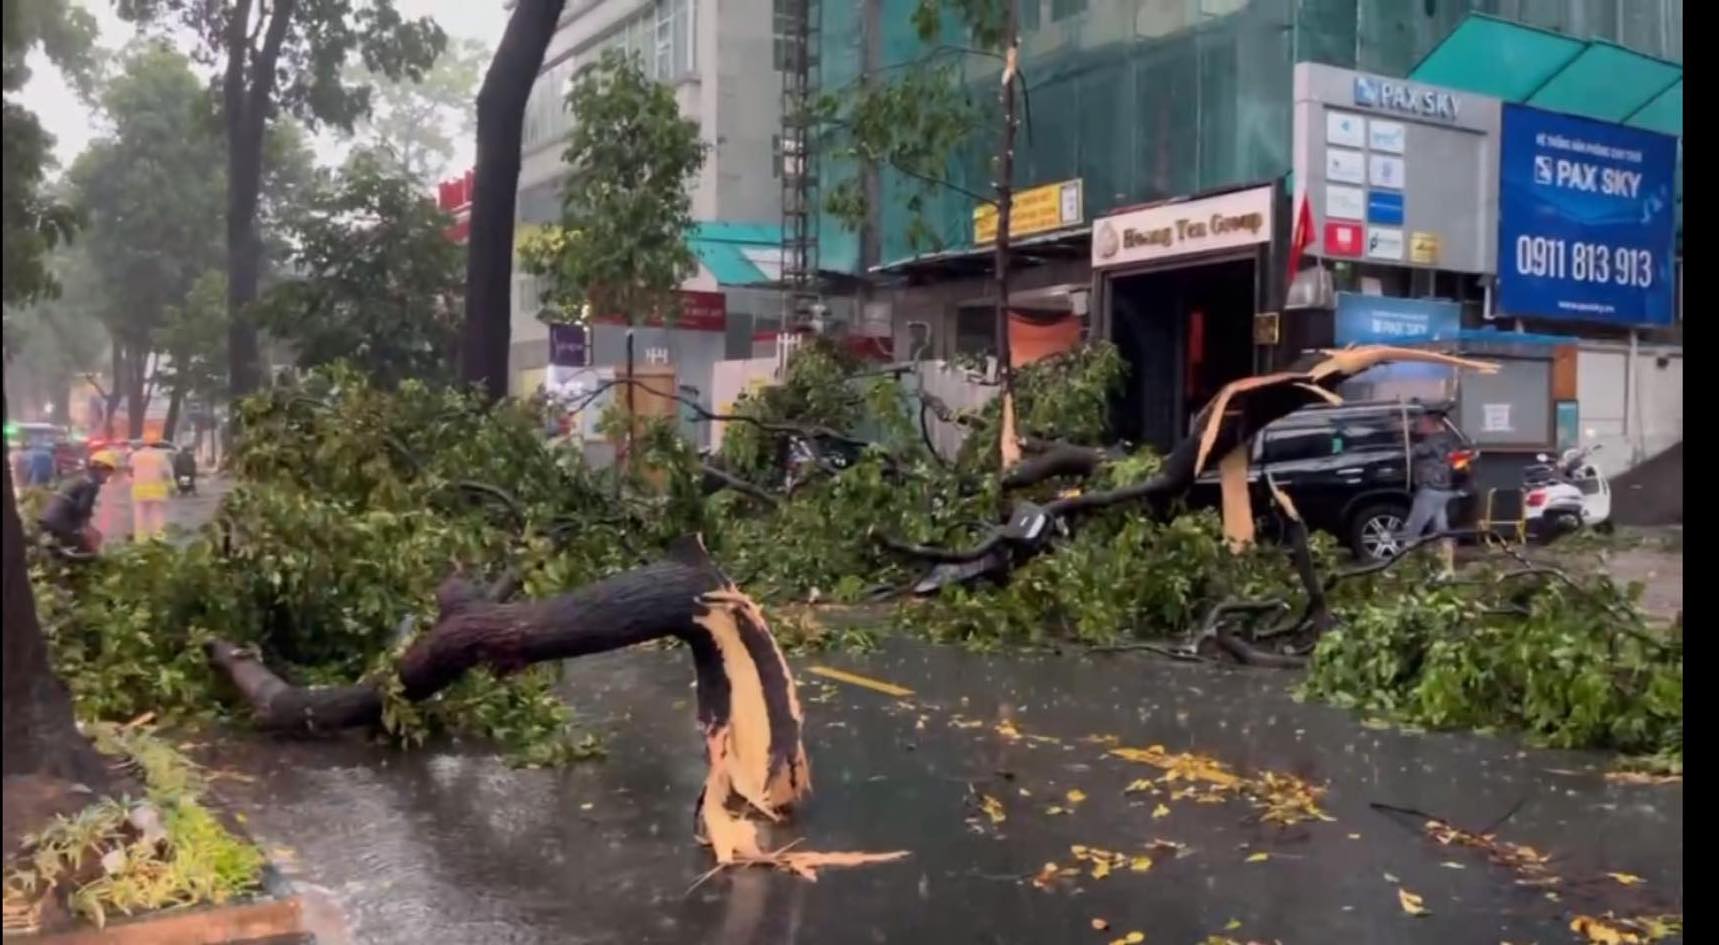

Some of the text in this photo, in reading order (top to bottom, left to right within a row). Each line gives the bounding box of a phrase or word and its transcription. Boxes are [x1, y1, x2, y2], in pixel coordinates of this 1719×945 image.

[1381, 83, 1461, 121] PAX SKY
[1556, 159, 1642, 198] PAX SKY
[1209, 212, 1263, 236] Group
[1516, 234, 1653, 288] 0911 813 913
